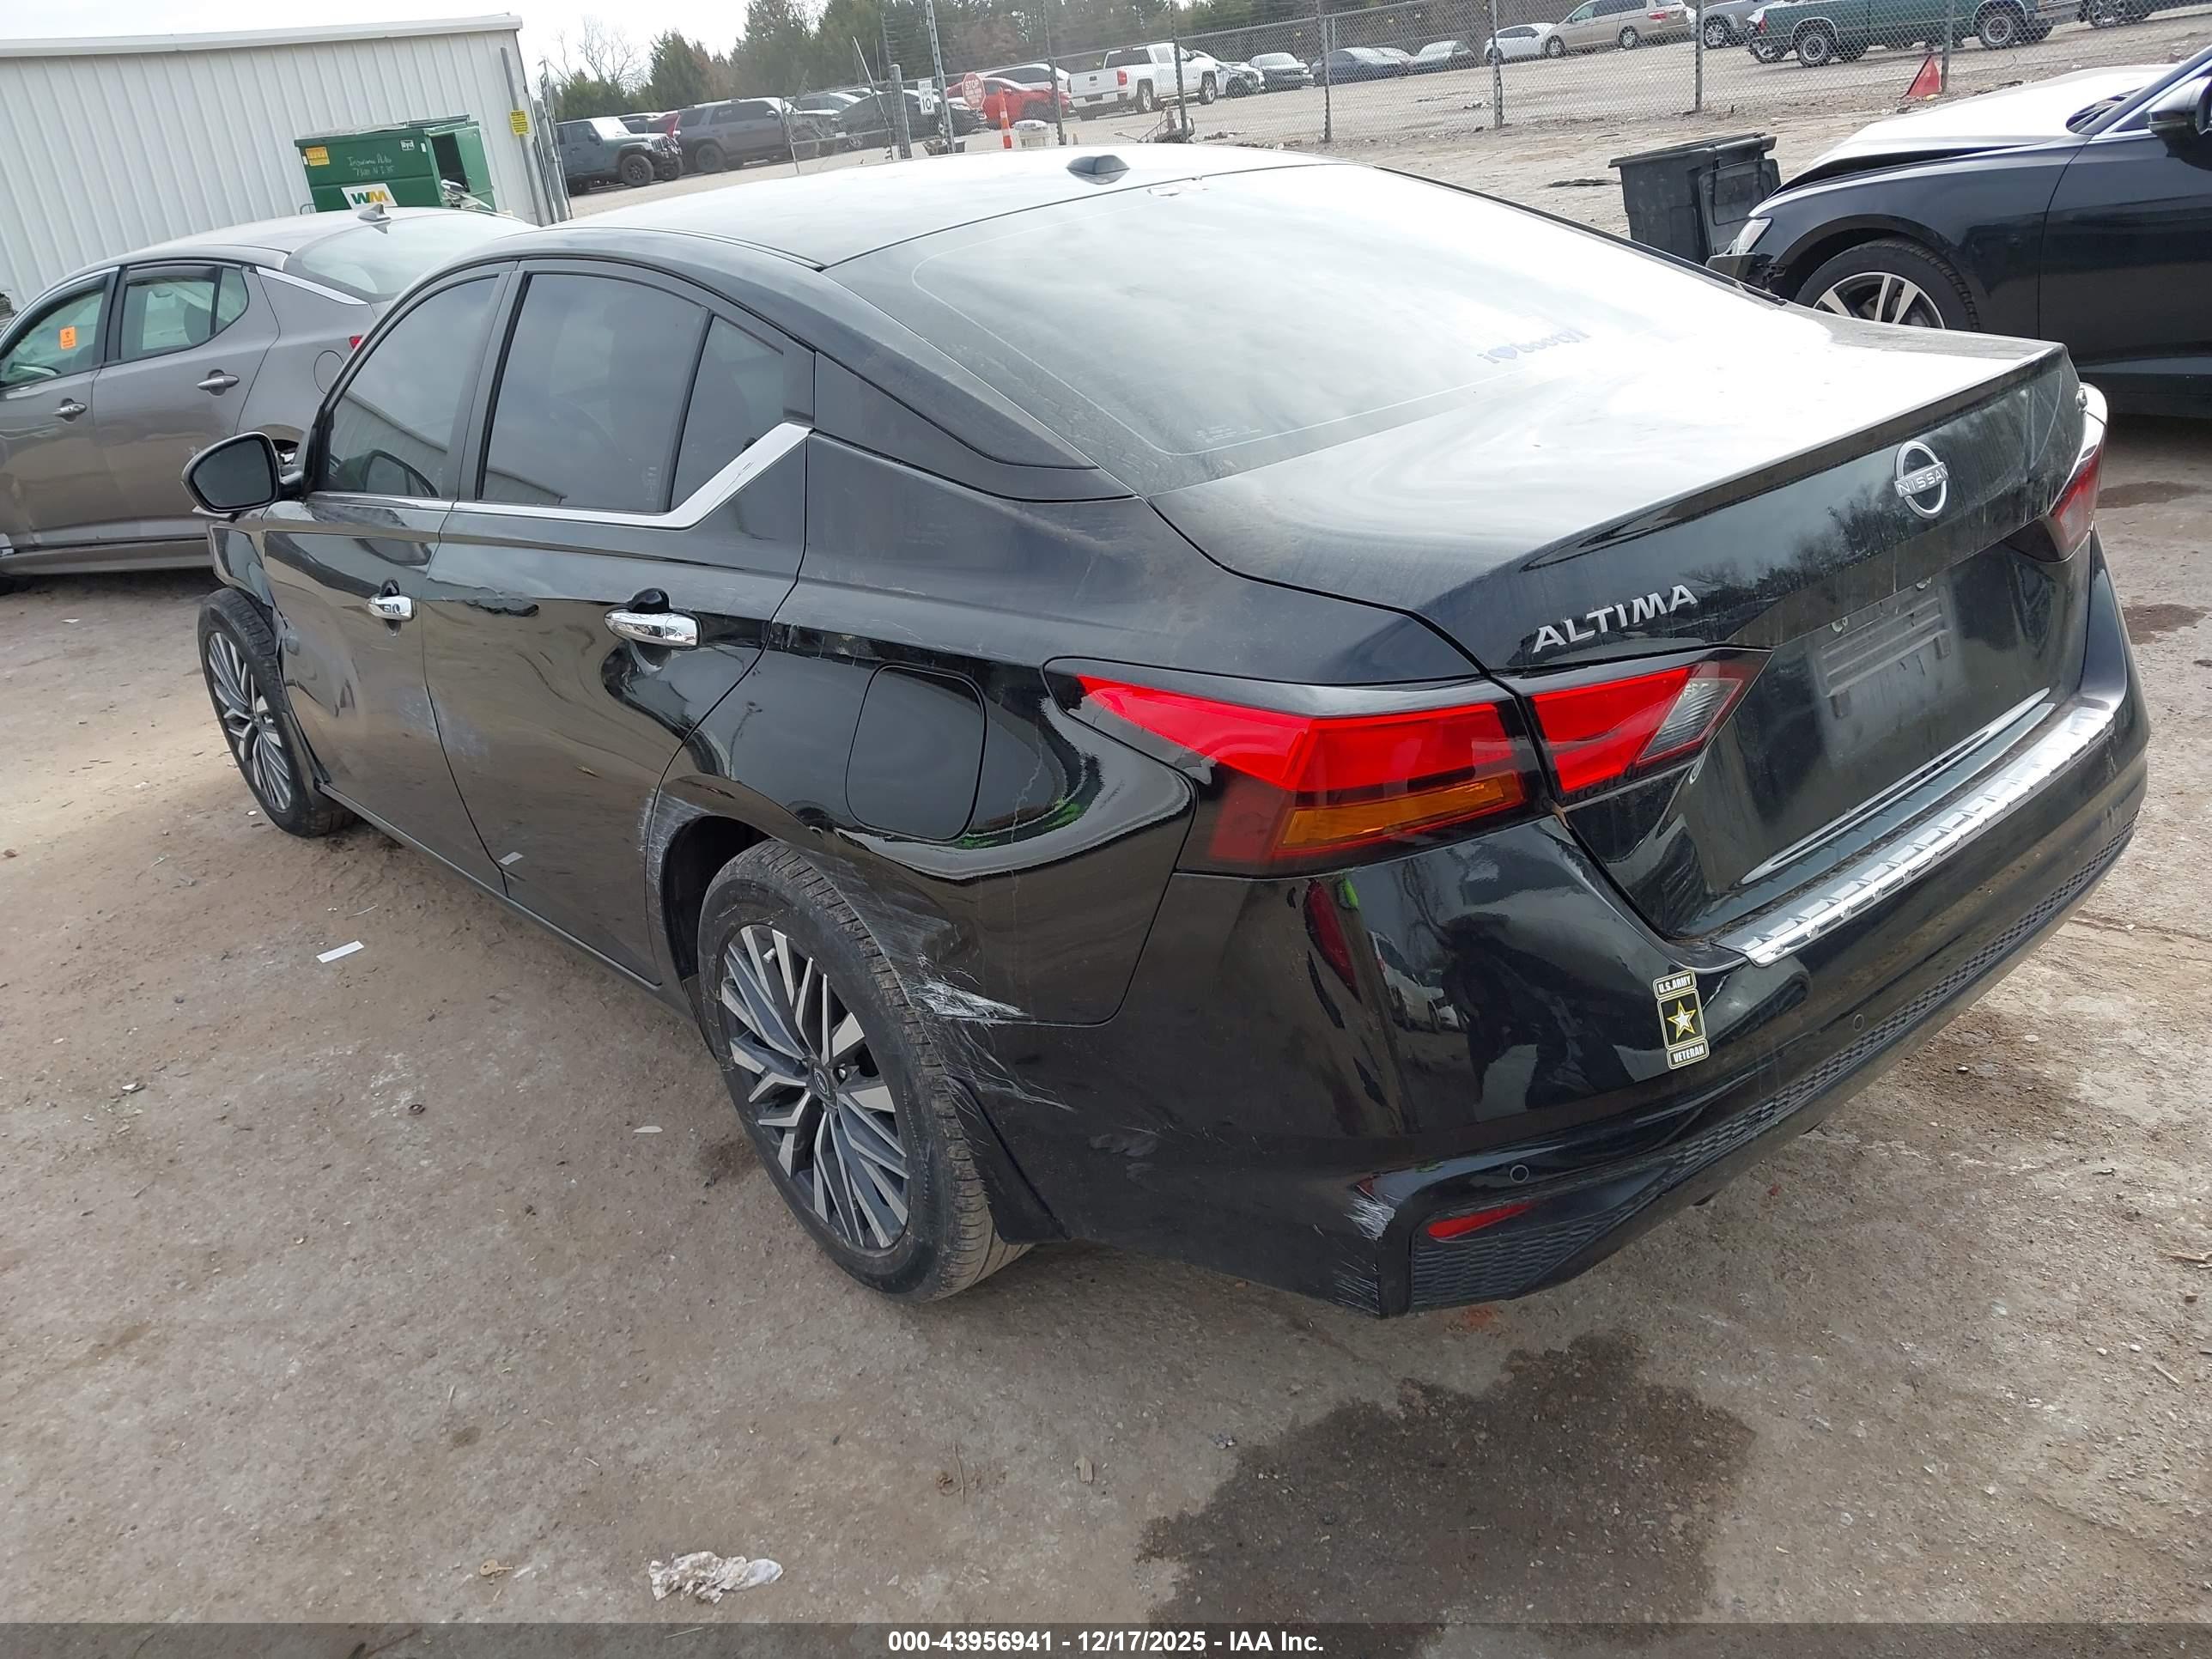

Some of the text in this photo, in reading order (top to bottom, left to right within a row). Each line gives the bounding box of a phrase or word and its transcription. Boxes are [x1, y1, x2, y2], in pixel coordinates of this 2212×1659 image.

[964, 79, 979, 90] STOP
[921, 97, 932, 111] 10
[349, 191, 389, 205] WM
[1897, 465, 1948, 495] NISSAN
[1531, 584, 1698, 654] ALTIMA
[1673, 1044, 1705, 1063] VETERAN
